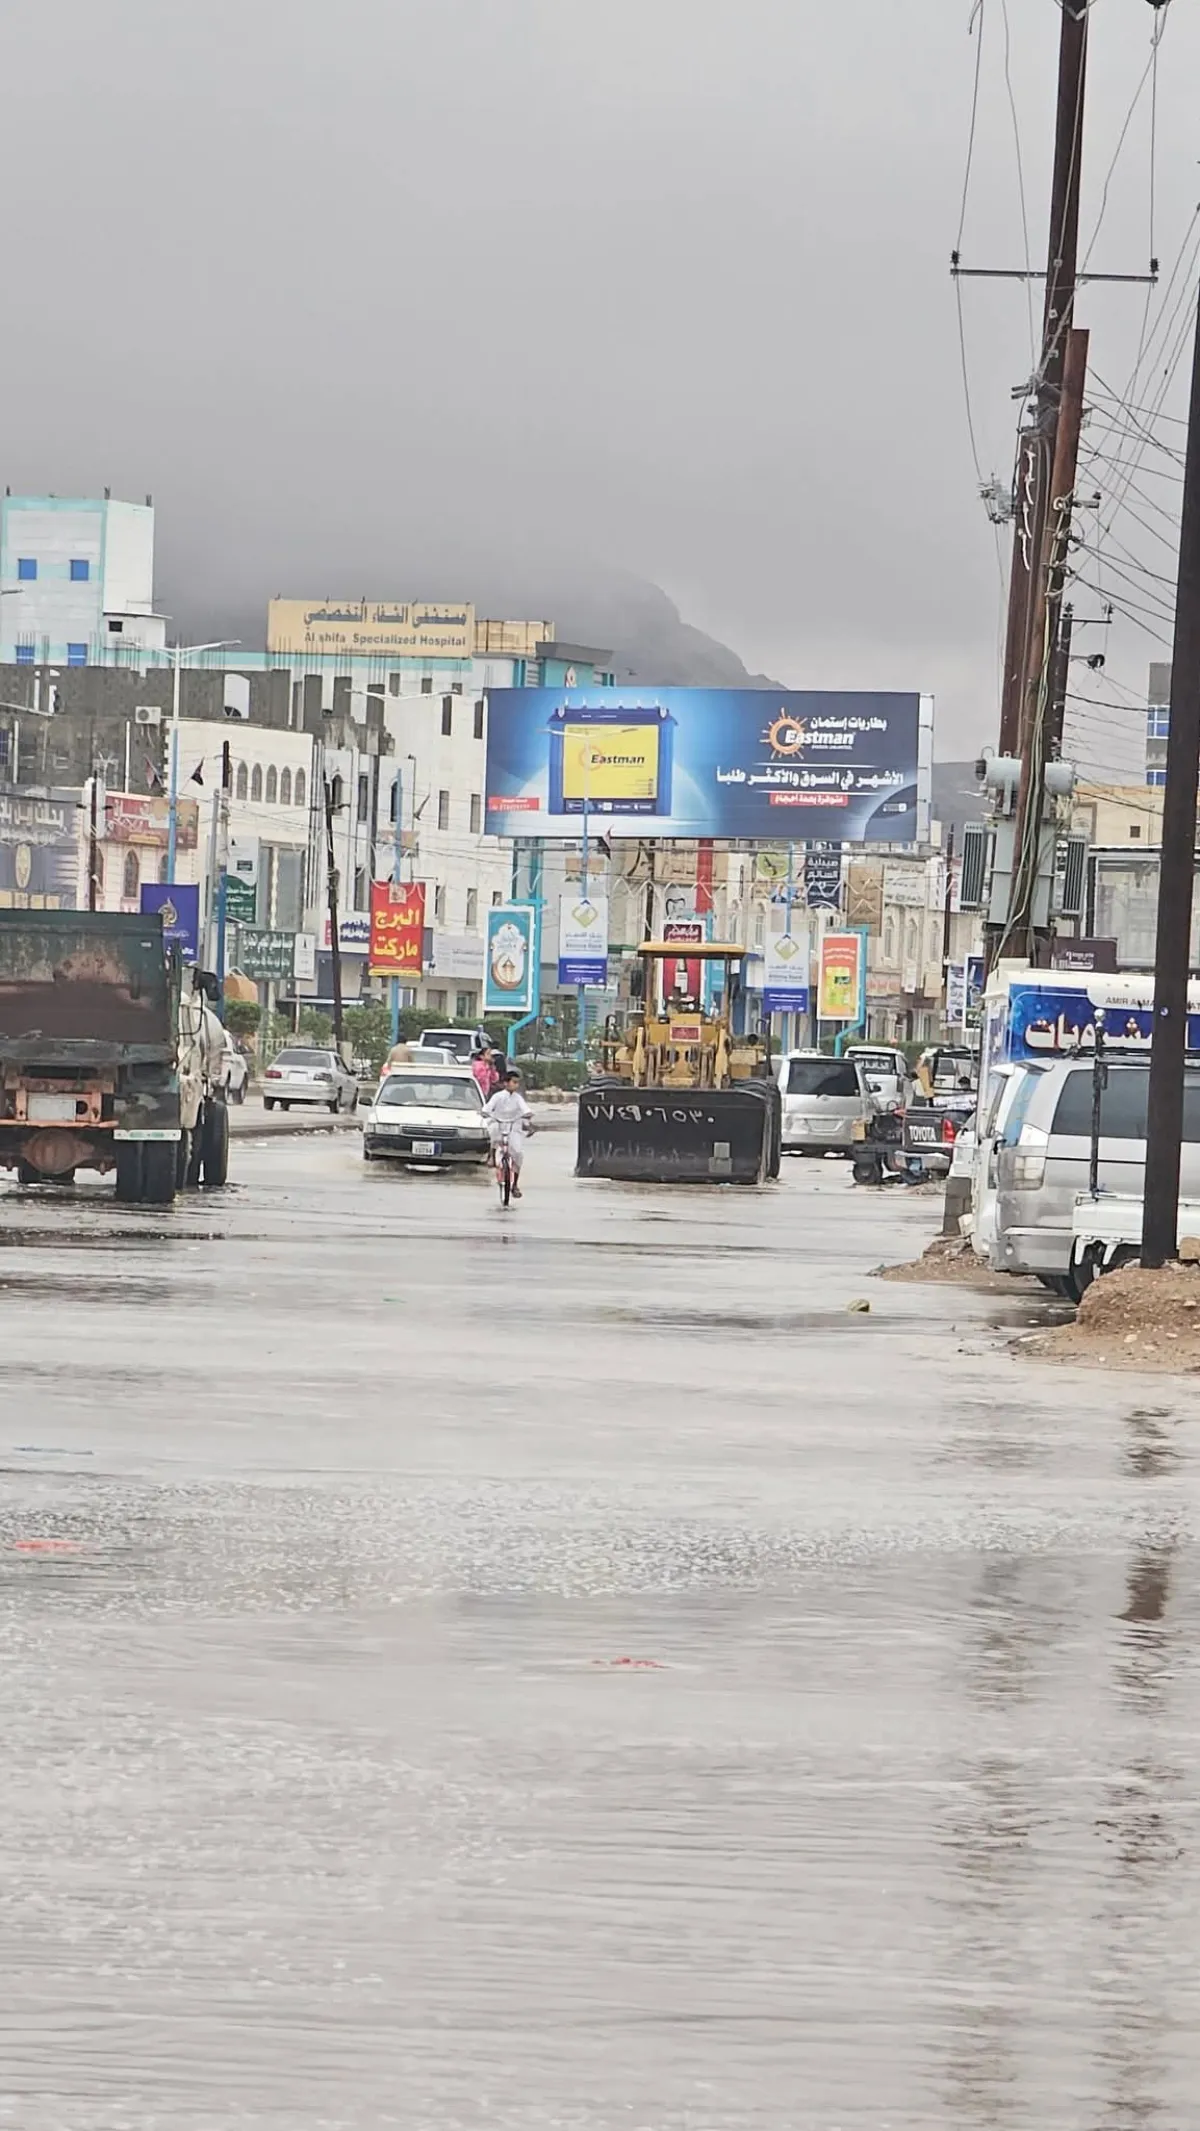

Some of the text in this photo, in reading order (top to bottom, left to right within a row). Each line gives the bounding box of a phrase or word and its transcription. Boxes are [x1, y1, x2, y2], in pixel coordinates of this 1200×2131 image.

[304, 604, 467, 630] مستشفى الشفاء التخصصي
[304, 632, 316, 643] Al
[352, 632, 416, 646] Specialized
[419, 634, 466, 648] Hospital
[810, 716, 887, 732] بطاريات إستمان
[784, 729, 855, 745] Eastman
[590, 753, 646, 765] Eastman
[747, 767, 799, 786] والأكثر
[800, 771, 840, 788] السوق
[840, 770, 854, 790] في
[856, 771, 904, 789] الأشهر
[808, 856, 839, 869] صيدلية
[375, 908, 420, 930] البرج
[373, 936, 418, 960] ماركت
[1105, 996, 1129, 1005] AMIR
[908, 1125, 937, 1142] TOYOTA
